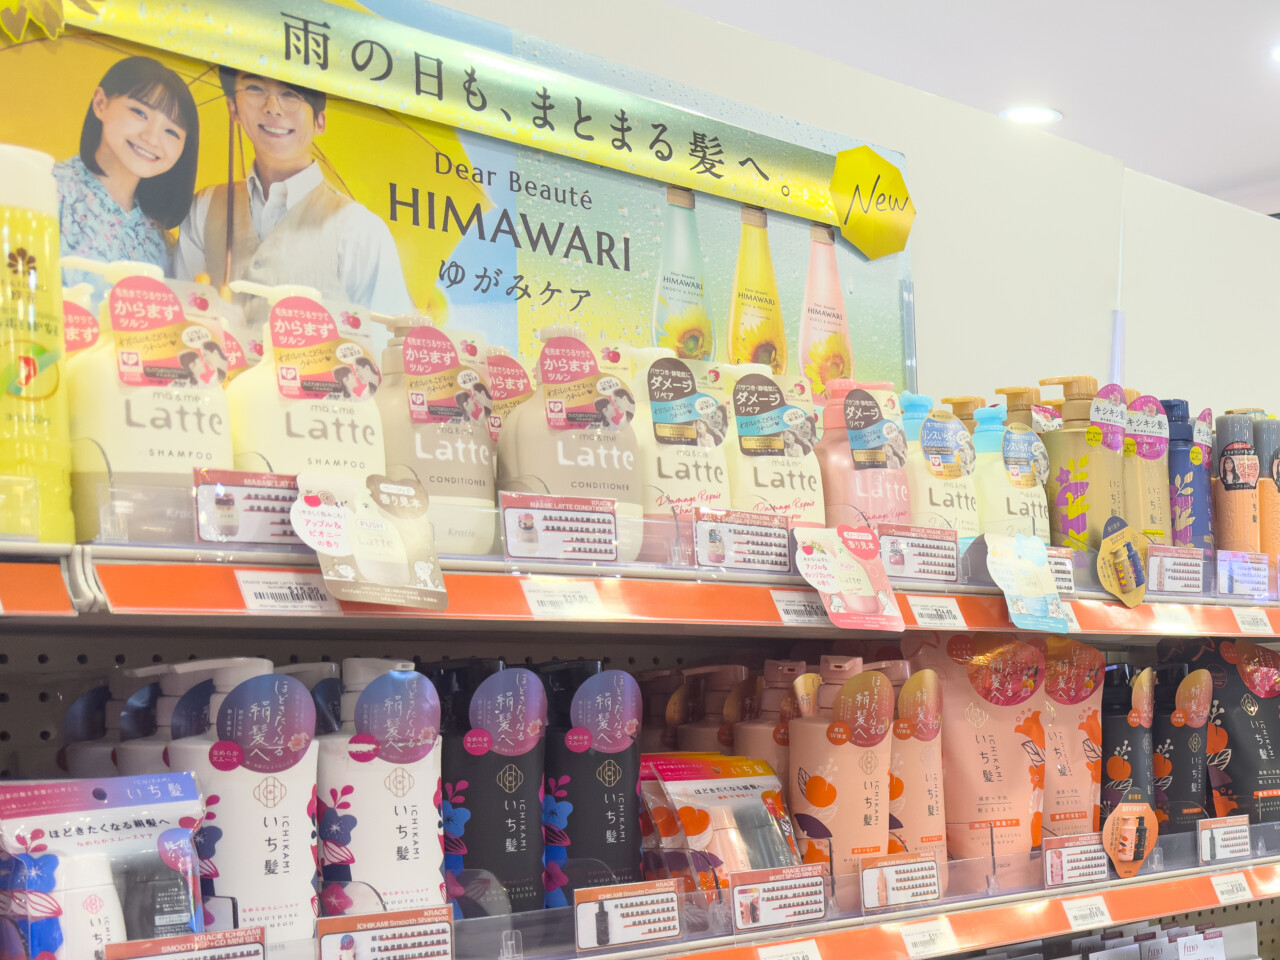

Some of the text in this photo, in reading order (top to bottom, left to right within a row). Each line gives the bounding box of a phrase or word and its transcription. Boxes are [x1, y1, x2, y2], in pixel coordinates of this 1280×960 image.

[280, 11, 791, 198] 雨の日も、まとまる髪へ。
[435, 152, 593, 210] Dear Beauté
[844, 174, 909, 226] New
[389, 182, 631, 272] HIMAWARI
[438, 259, 592, 312] ゆがみケア
[663, 276, 704, 291] HIMAWARI
[738, 292, 776, 306] HIMAWARI
[807, 307, 843, 321] HIMAWARI
[650, 376, 693, 393] ダメージ
[654, 391, 674, 400] リペア
[736, 391, 781, 407] ダメージ
[739, 405, 761, 414] リペア
[124, 398, 223, 436] Latte
[285, 411, 376, 446] Latte
[149, 448, 213, 461] SHAMPOO
[415, 433, 489, 465] Latte
[556, 440, 635, 472] Latte
[307, 457, 366, 470] SHAMPOO
[656, 456, 724, 484] Latte
[429, 475, 486, 487] CONDITIONER
[571, 481, 630, 492] CONDITIONER
[753, 466, 817, 492] Latte
[855, 477, 909, 502] Latte
[928, 487, 977, 514] Latte
[1006, 496, 1049, 518] Latte
[975, 734, 994, 783] いち髪
[126, 782, 185, 800] いち髪
[863, 781, 873, 826] いち髪
[48, 817, 171, 839] ほどきたくなる絹髪へ
[504, 799, 518, 853] いち髪
[519, 799, 527, 851] ICHIKAMI
[604, 793, 618, 844] いち髪
[618, 793, 626, 843] ICHIKAMI
[281, 815, 290, 874] ICHIKAMI
[394, 805, 410, 862] いち髪
[410, 804, 420, 860] ICHIKAMI
[263, 816, 279, 876] いち髪
[357, 914, 449, 931] ICHIKAMI Smooth Shampoo
[424, 908, 448, 917] KRACIE
[161, 944, 197, 954] SMOOTH
[226, 938, 242, 947] MINI
[244, 936, 261, 944] SET
[194, 929, 261, 943] KRACIE ICHIKAMI
